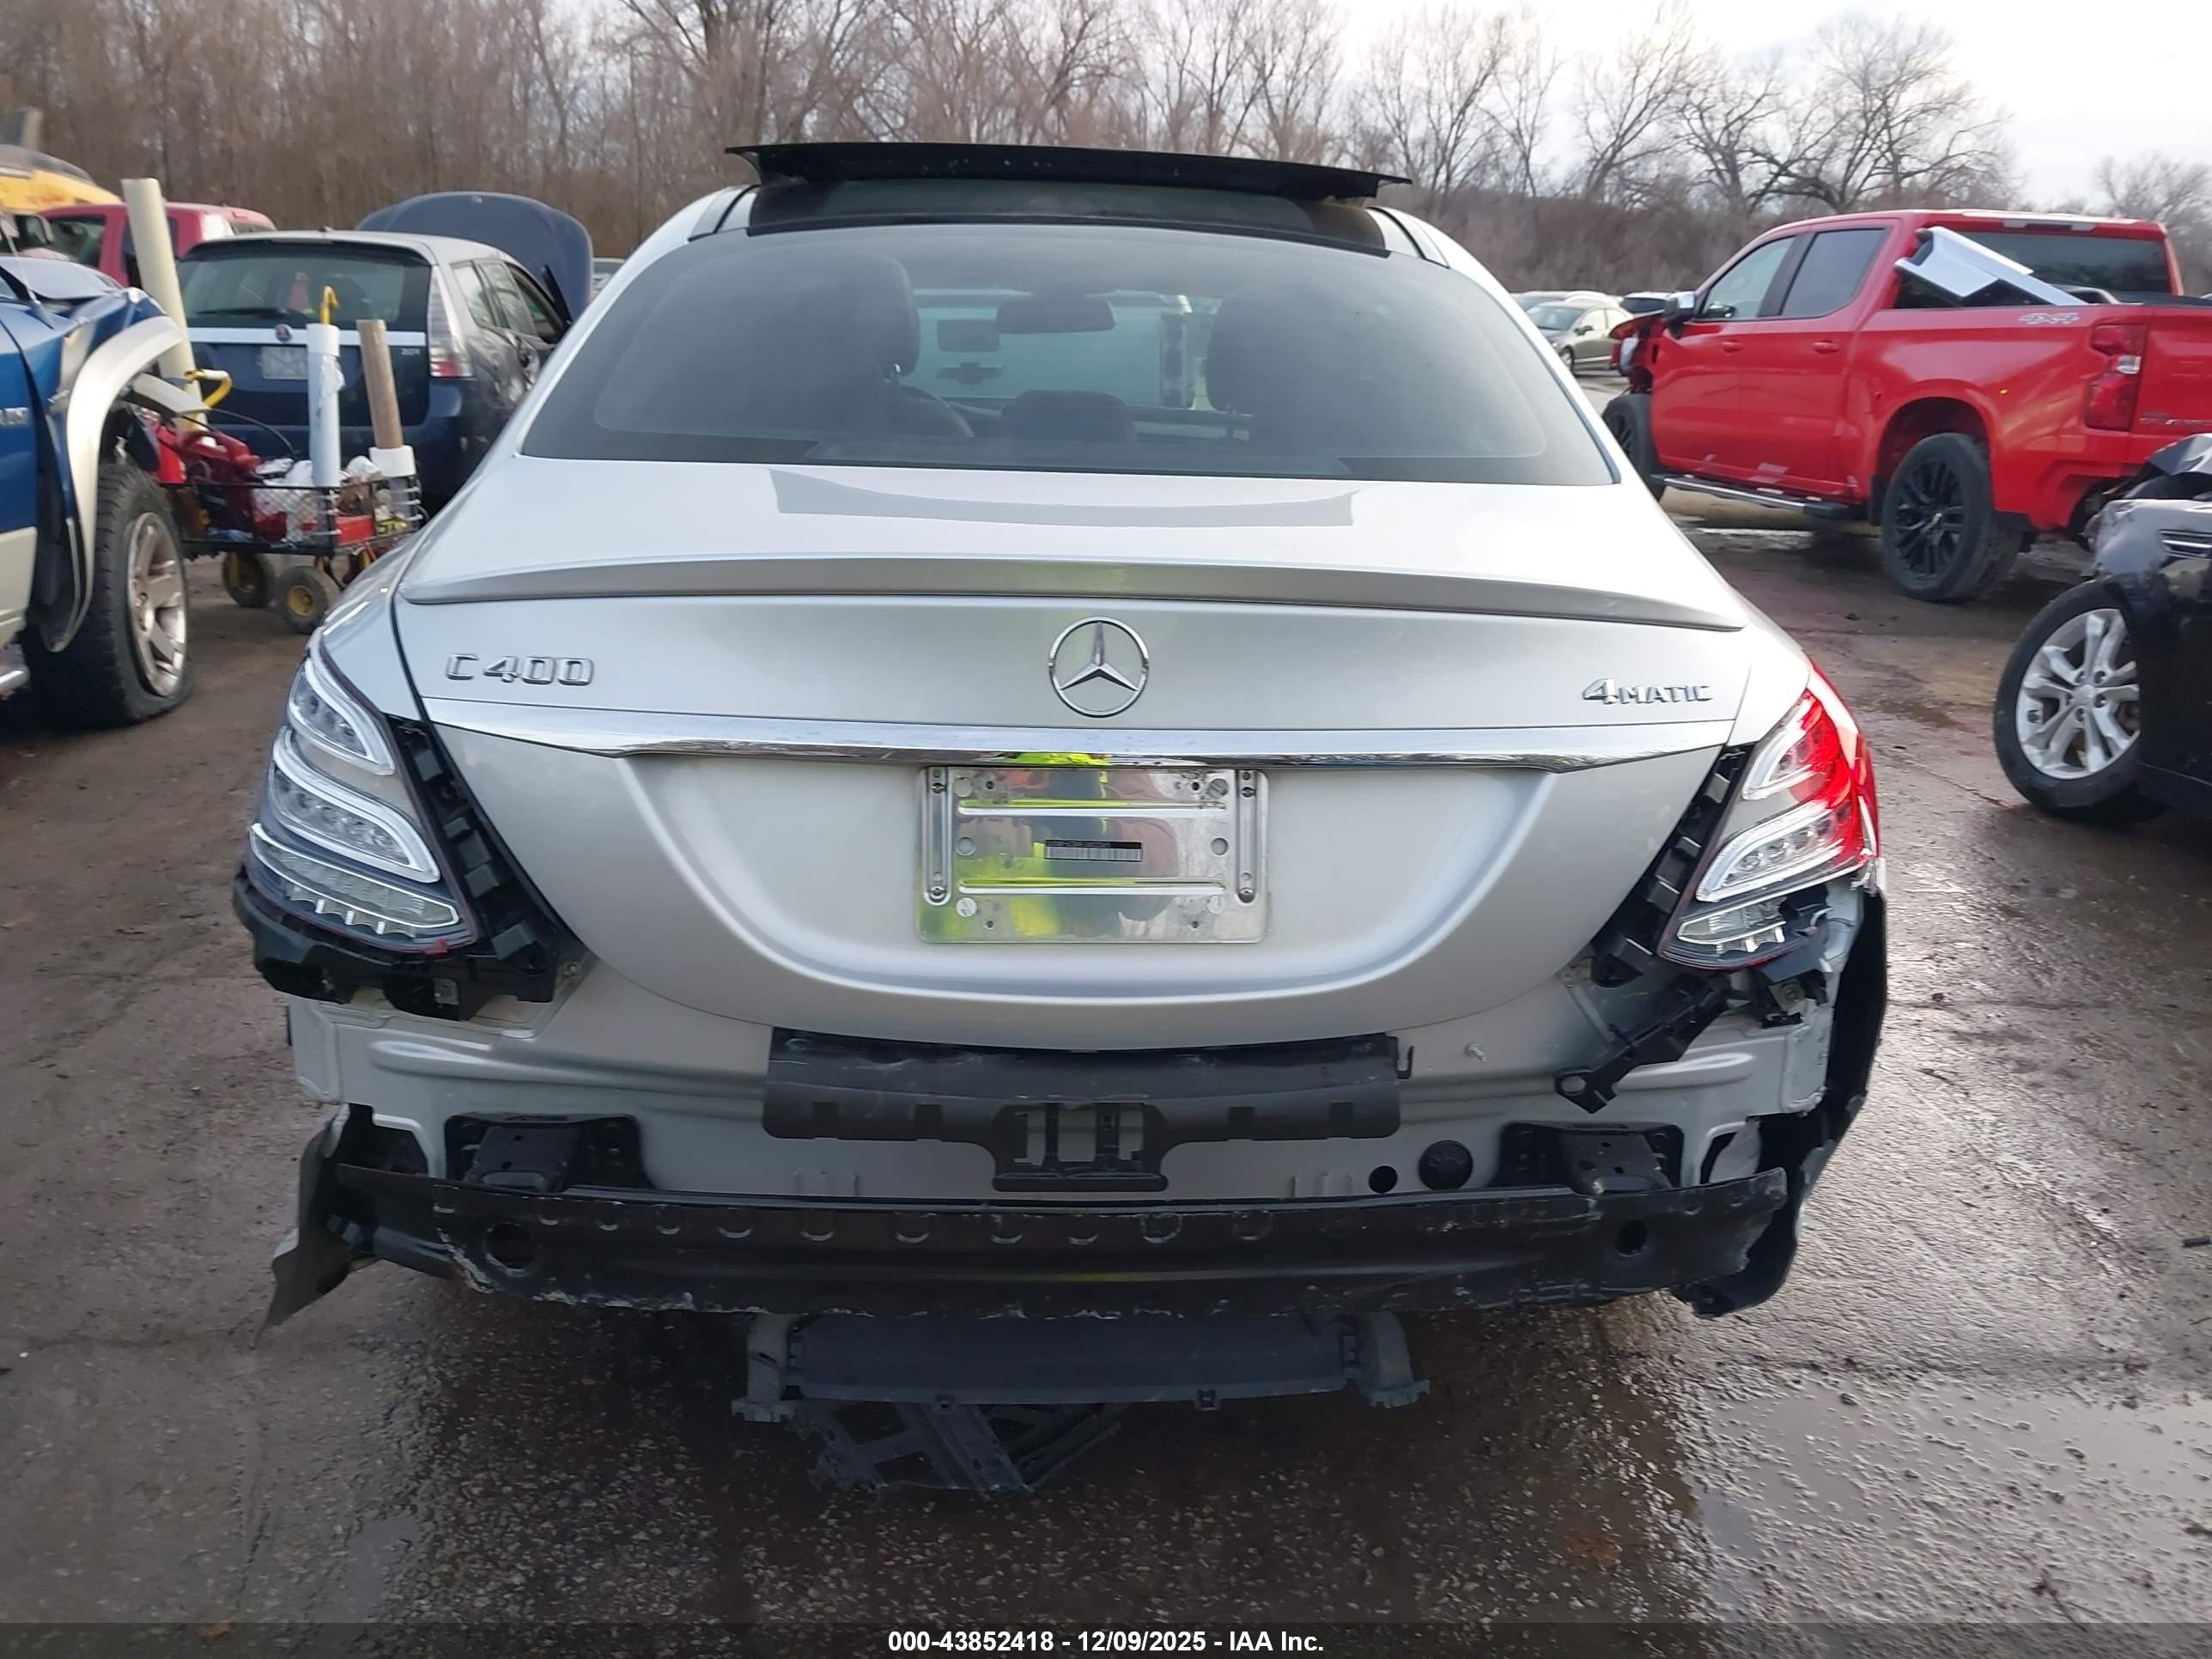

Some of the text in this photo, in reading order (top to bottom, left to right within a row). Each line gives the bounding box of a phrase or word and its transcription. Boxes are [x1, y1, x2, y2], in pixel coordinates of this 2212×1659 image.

[446, 653, 594, 686] C 400
[1583, 678, 1714, 705] 4MATIC
